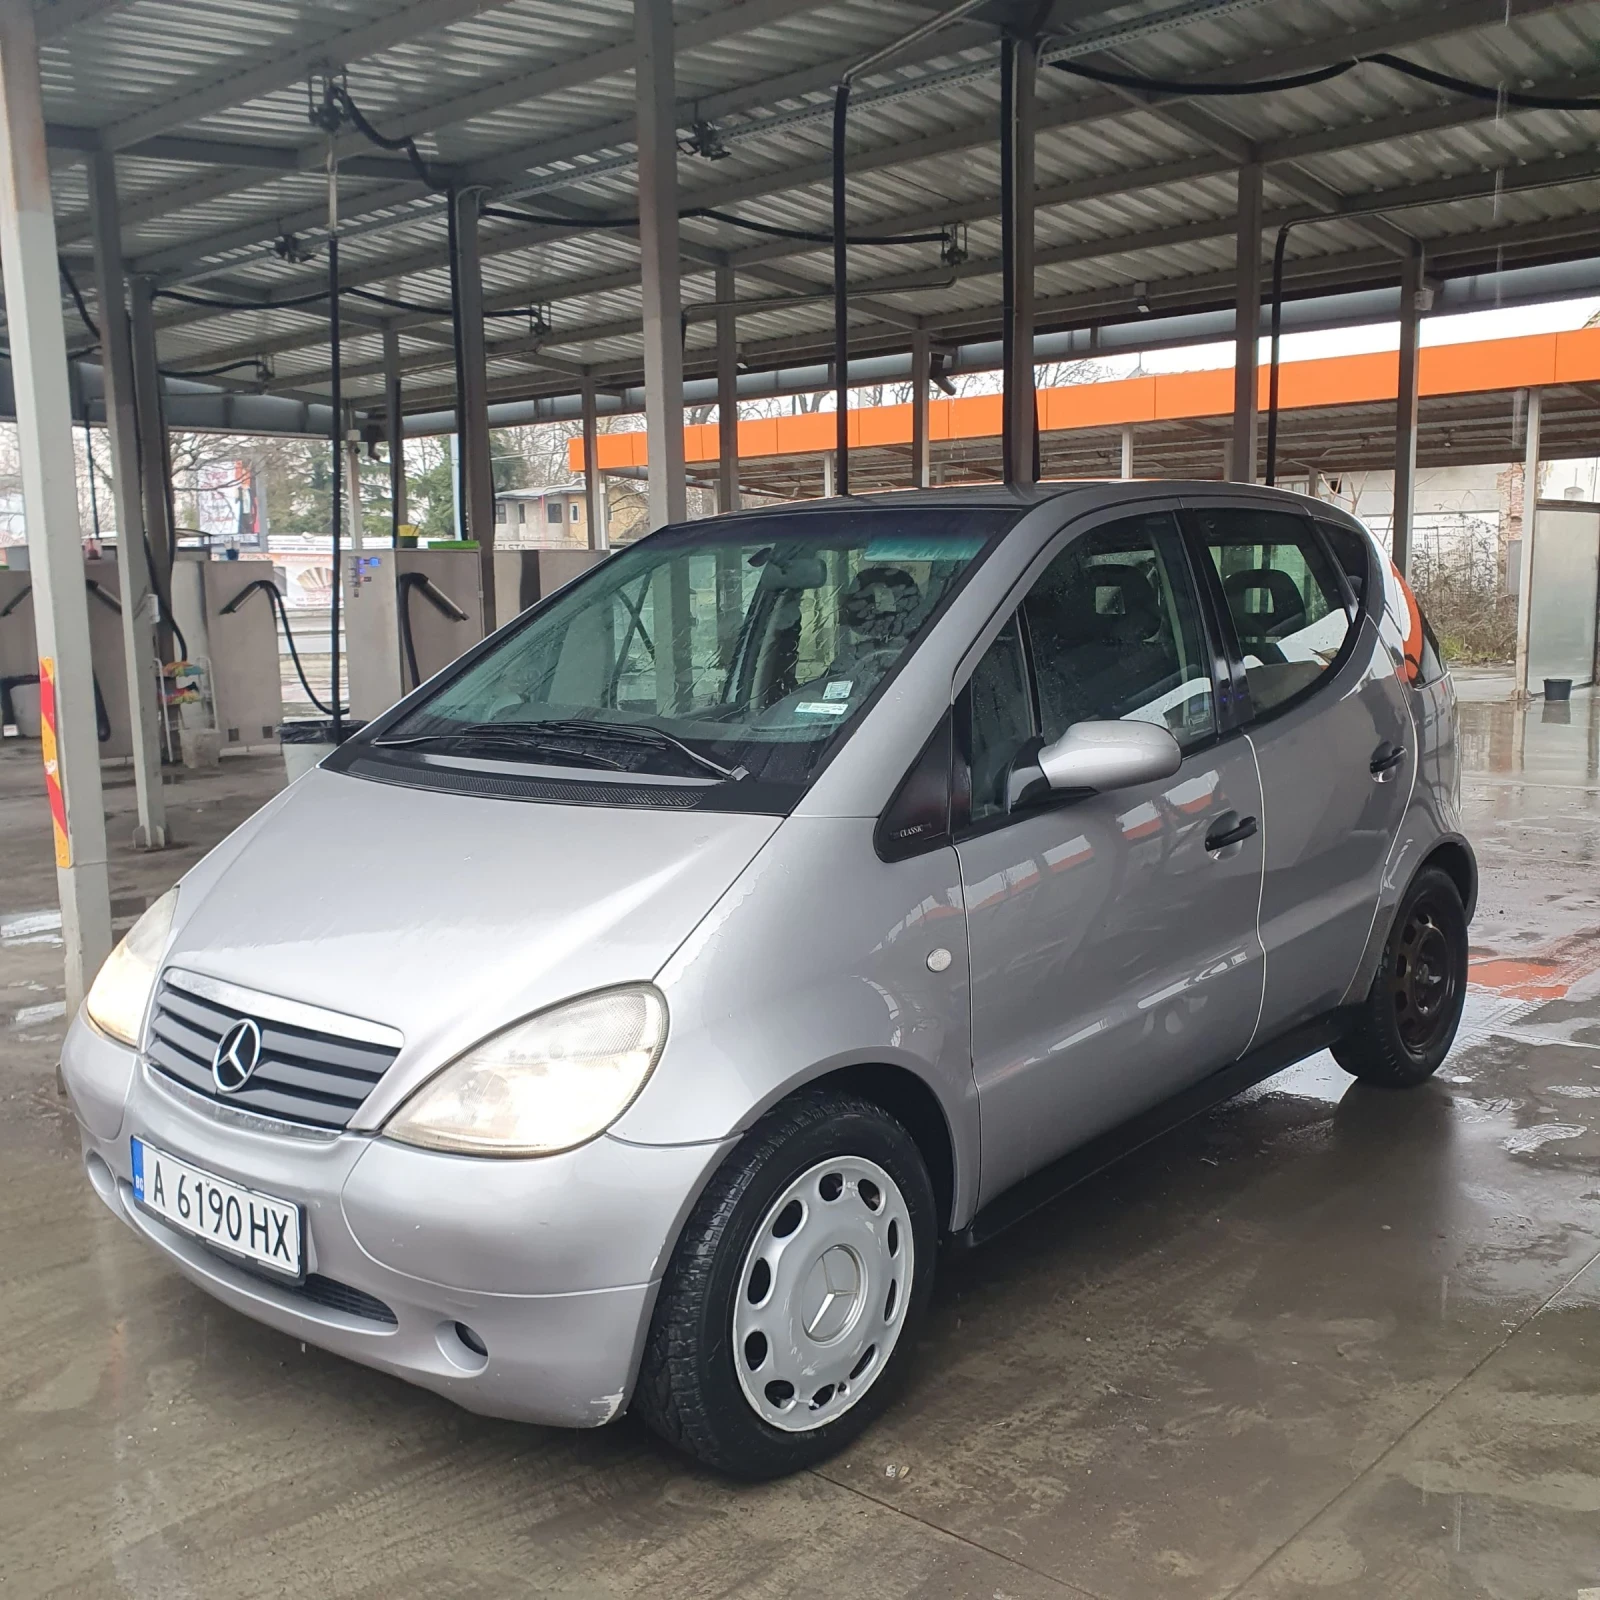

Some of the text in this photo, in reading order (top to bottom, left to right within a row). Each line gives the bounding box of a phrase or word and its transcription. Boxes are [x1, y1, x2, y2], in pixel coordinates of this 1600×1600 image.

[900, 824, 923, 838] CLASSIC
[135, 1174, 144, 1191] BG
[153, 1160, 291, 1262] A 6190 HX
